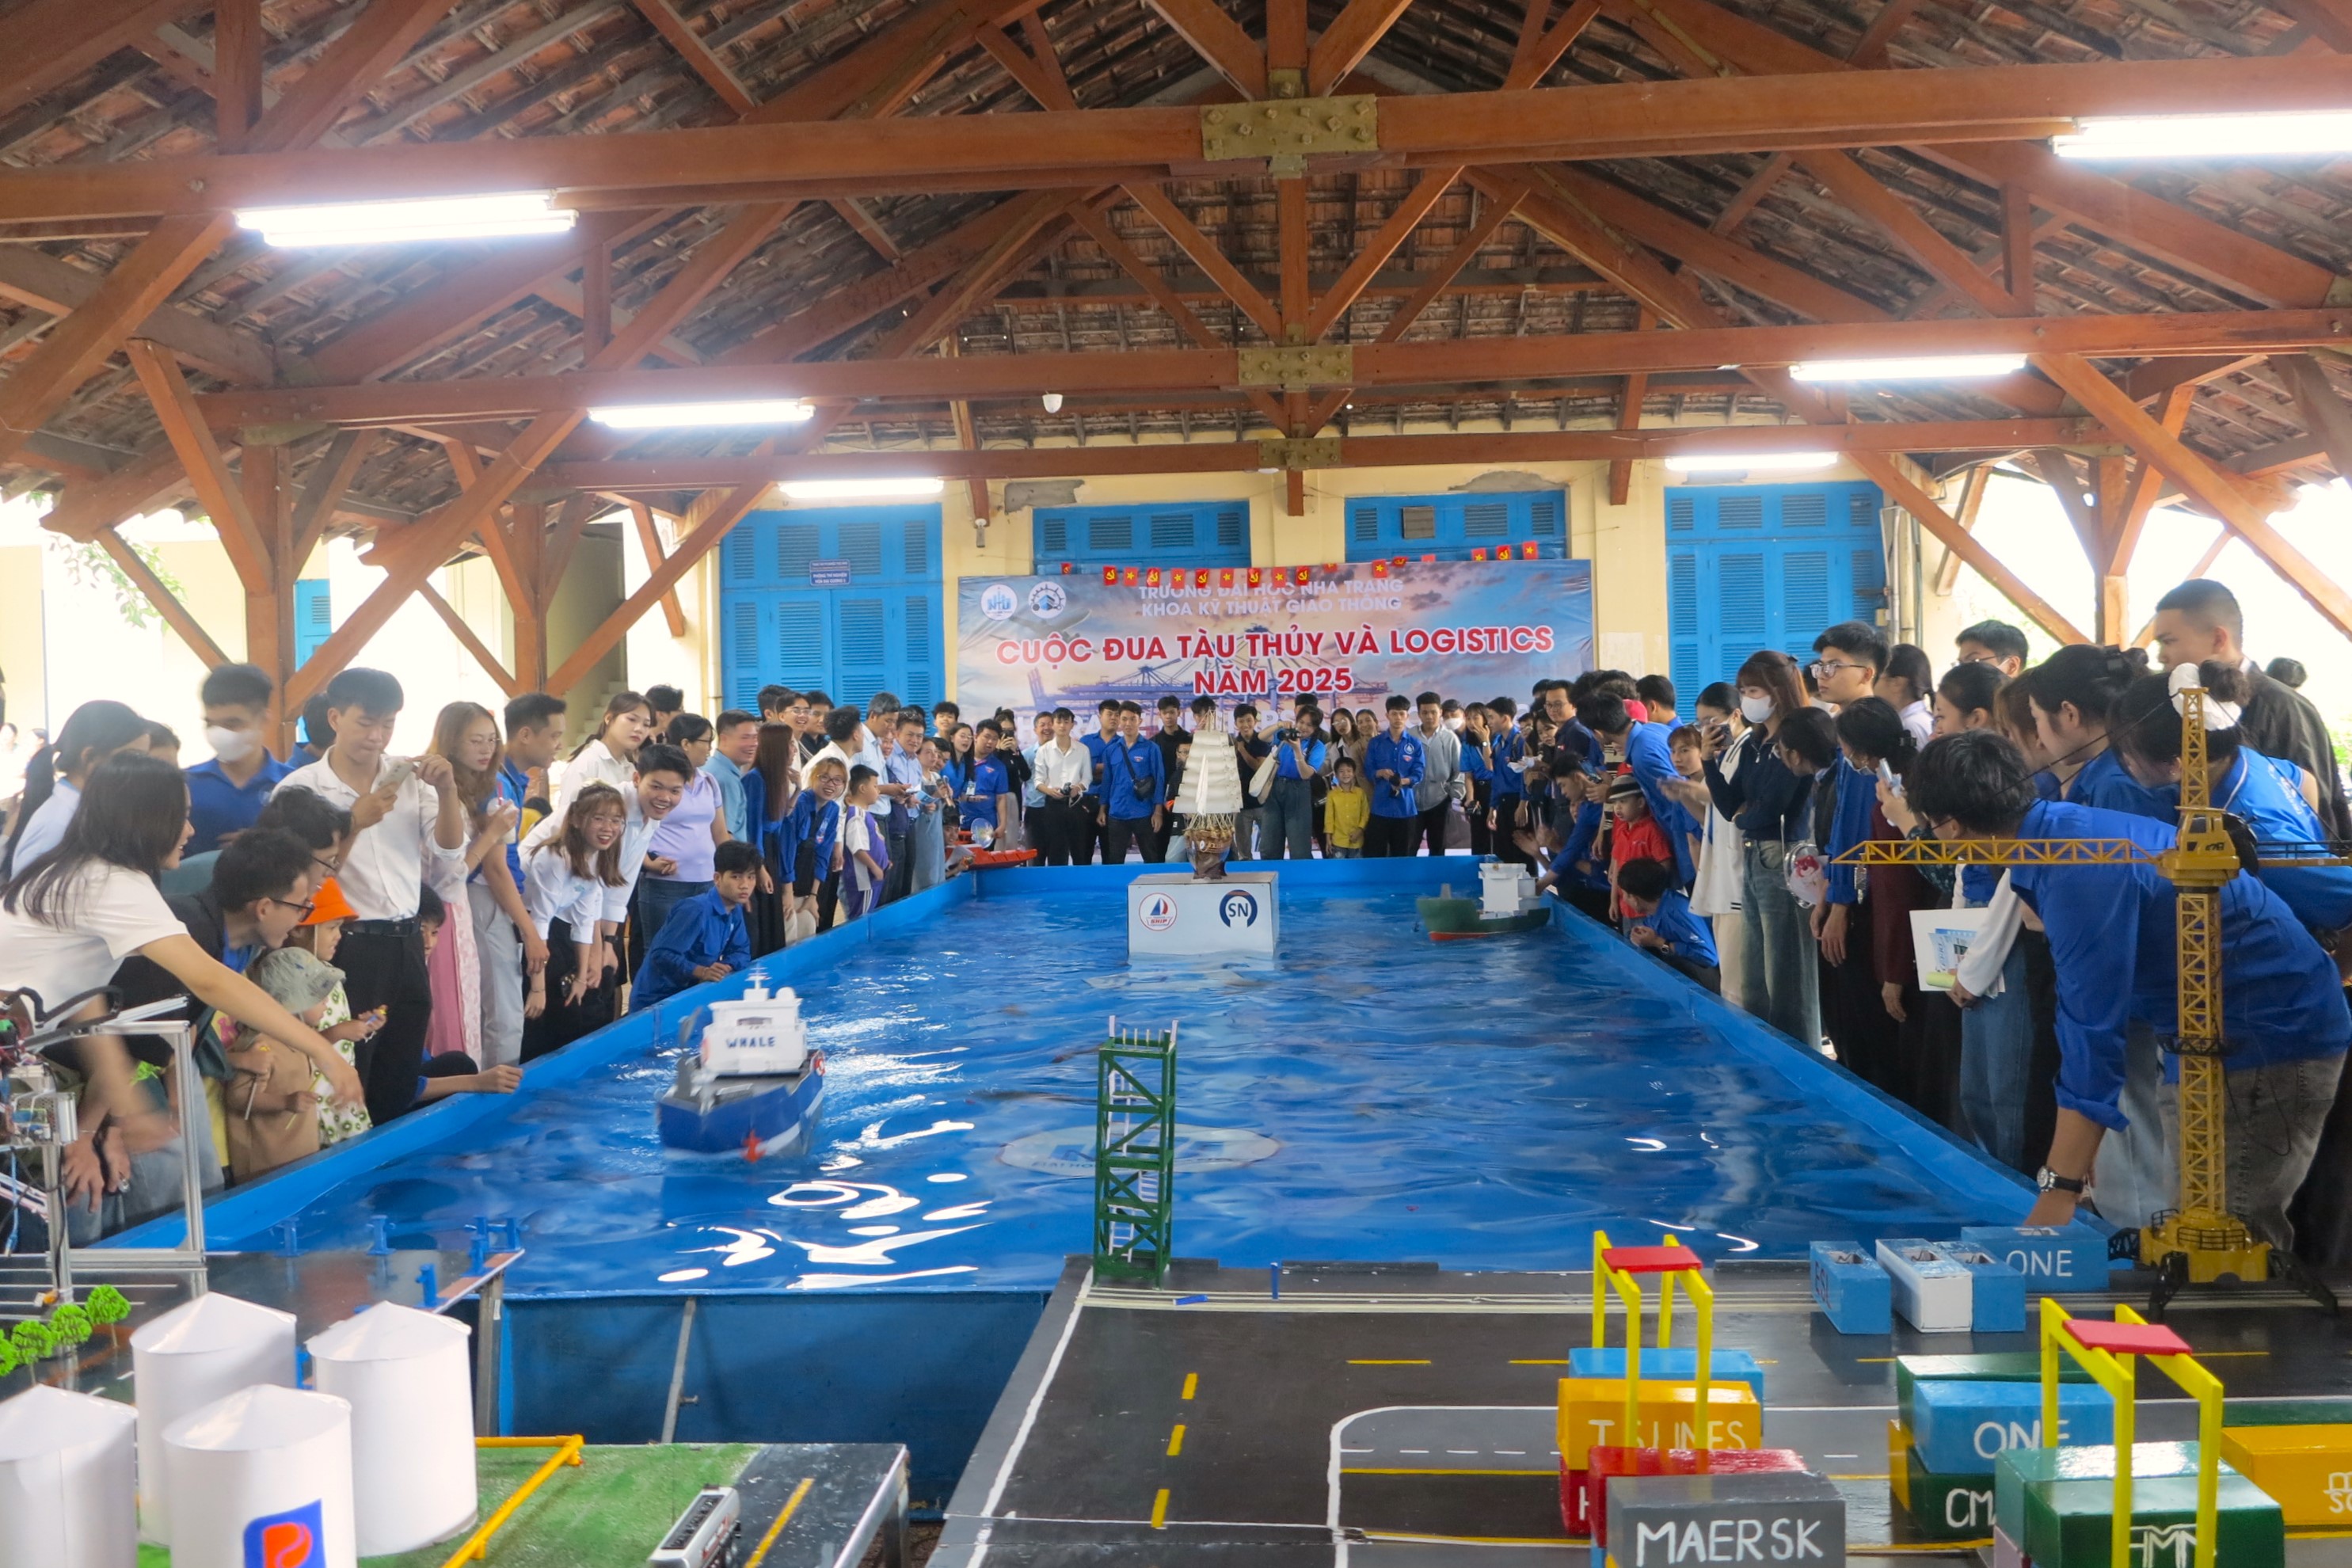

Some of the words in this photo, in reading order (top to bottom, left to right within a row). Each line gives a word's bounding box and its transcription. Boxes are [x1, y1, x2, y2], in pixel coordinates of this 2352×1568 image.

[1300, 580, 1338, 595] NHA
[1343, 579, 1403, 595] TRANG
[1142, 601, 1193, 617] KHOA
[1198, 598, 1220, 615] KỸ
[1226, 596, 1282, 617] THUẬT
[1286, 599, 1333, 614] GIAO
[1338, 593, 1402, 612] THÔNG
[995, 632, 1093, 669] CUỘC
[1102, 636, 1167, 662] ĐUA
[1177, 628, 1235, 659] TÀU
[1246, 623, 1323, 658] THỦY
[1334, 623, 1380, 655] VÀ
[1390, 626, 1553, 654] LOGISTICS
[1194, 664, 1267, 695] NĂM
[1277, 667, 1353, 693] 2025
[1227, 903, 1249, 918] SN
[726, 1036, 775, 1049] WHALE
[2006, 1249, 2073, 1278] ONE
[1946, 1487, 1996, 1528] CM
[1636, 1518, 1824, 1567] MAERSK
